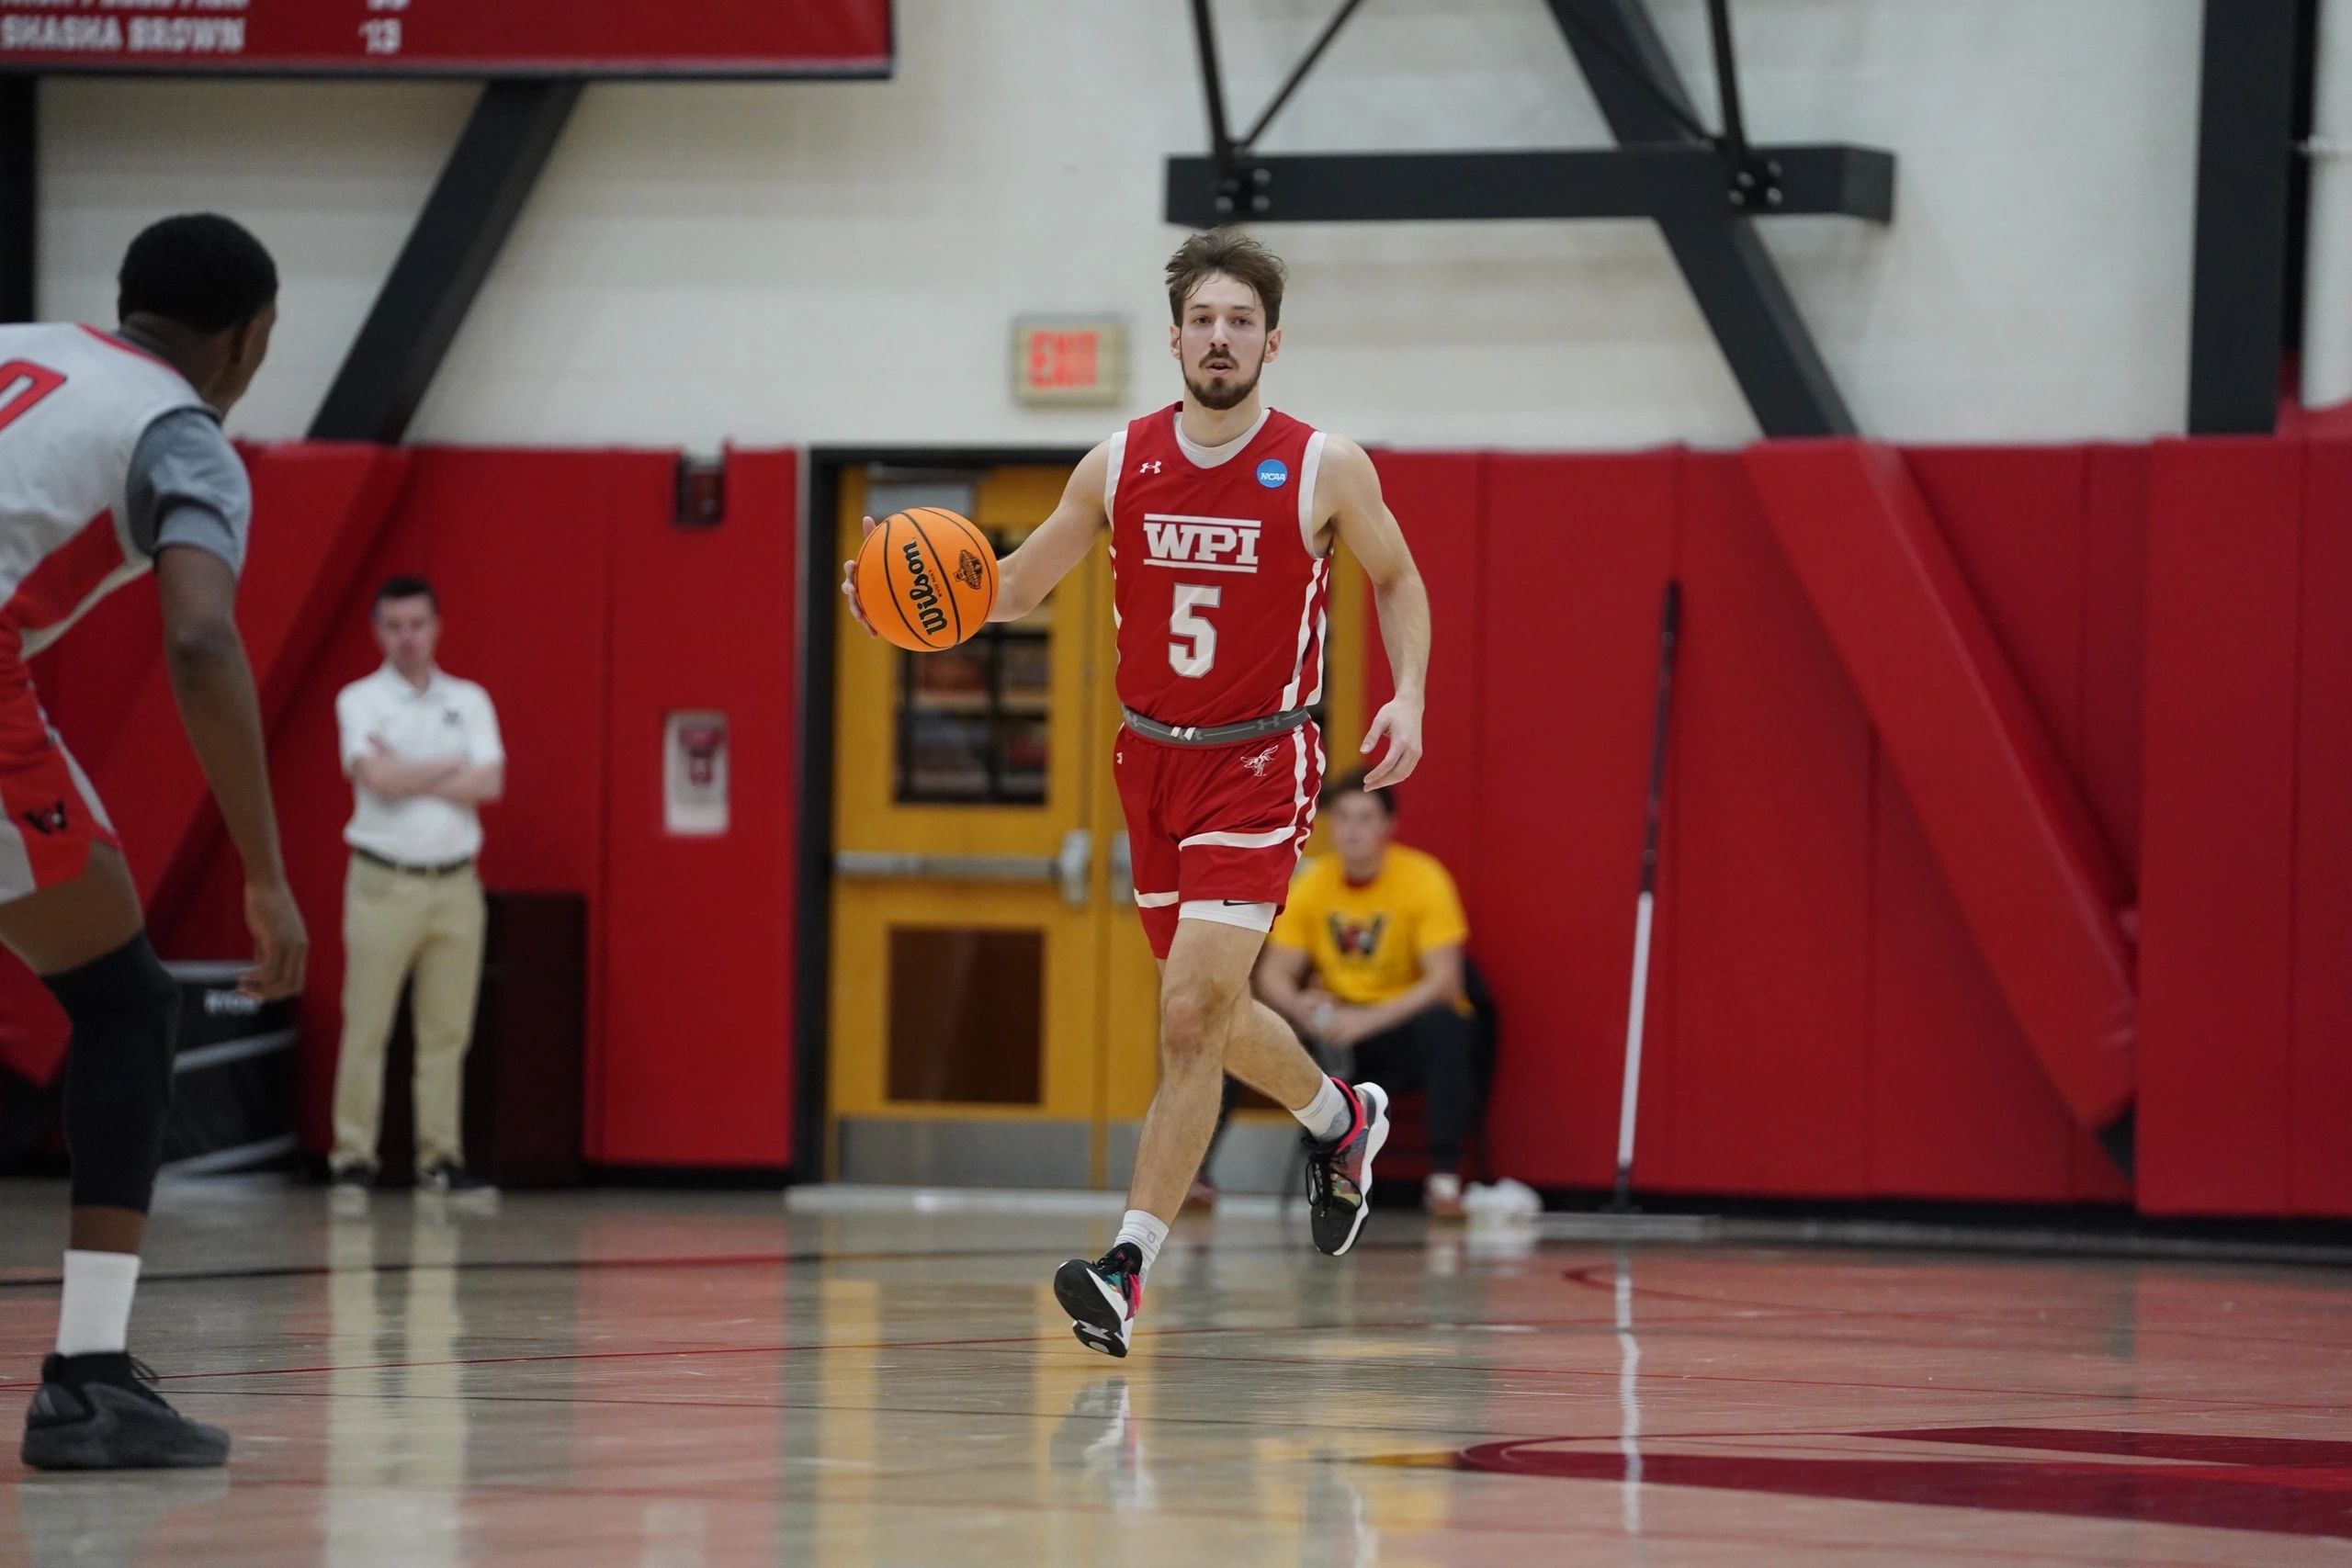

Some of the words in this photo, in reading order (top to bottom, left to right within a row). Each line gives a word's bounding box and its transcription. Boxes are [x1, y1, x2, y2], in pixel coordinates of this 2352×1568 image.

[128, 17, 246, 52] BROWN
[1028, 332, 1100, 388] EXIT
[1260, 472, 1286, 482] NCAA
[1143, 521, 1261, 565] WPI
[902, 540, 948, 636] Wilson
[1168, 581, 1222, 679] 5
